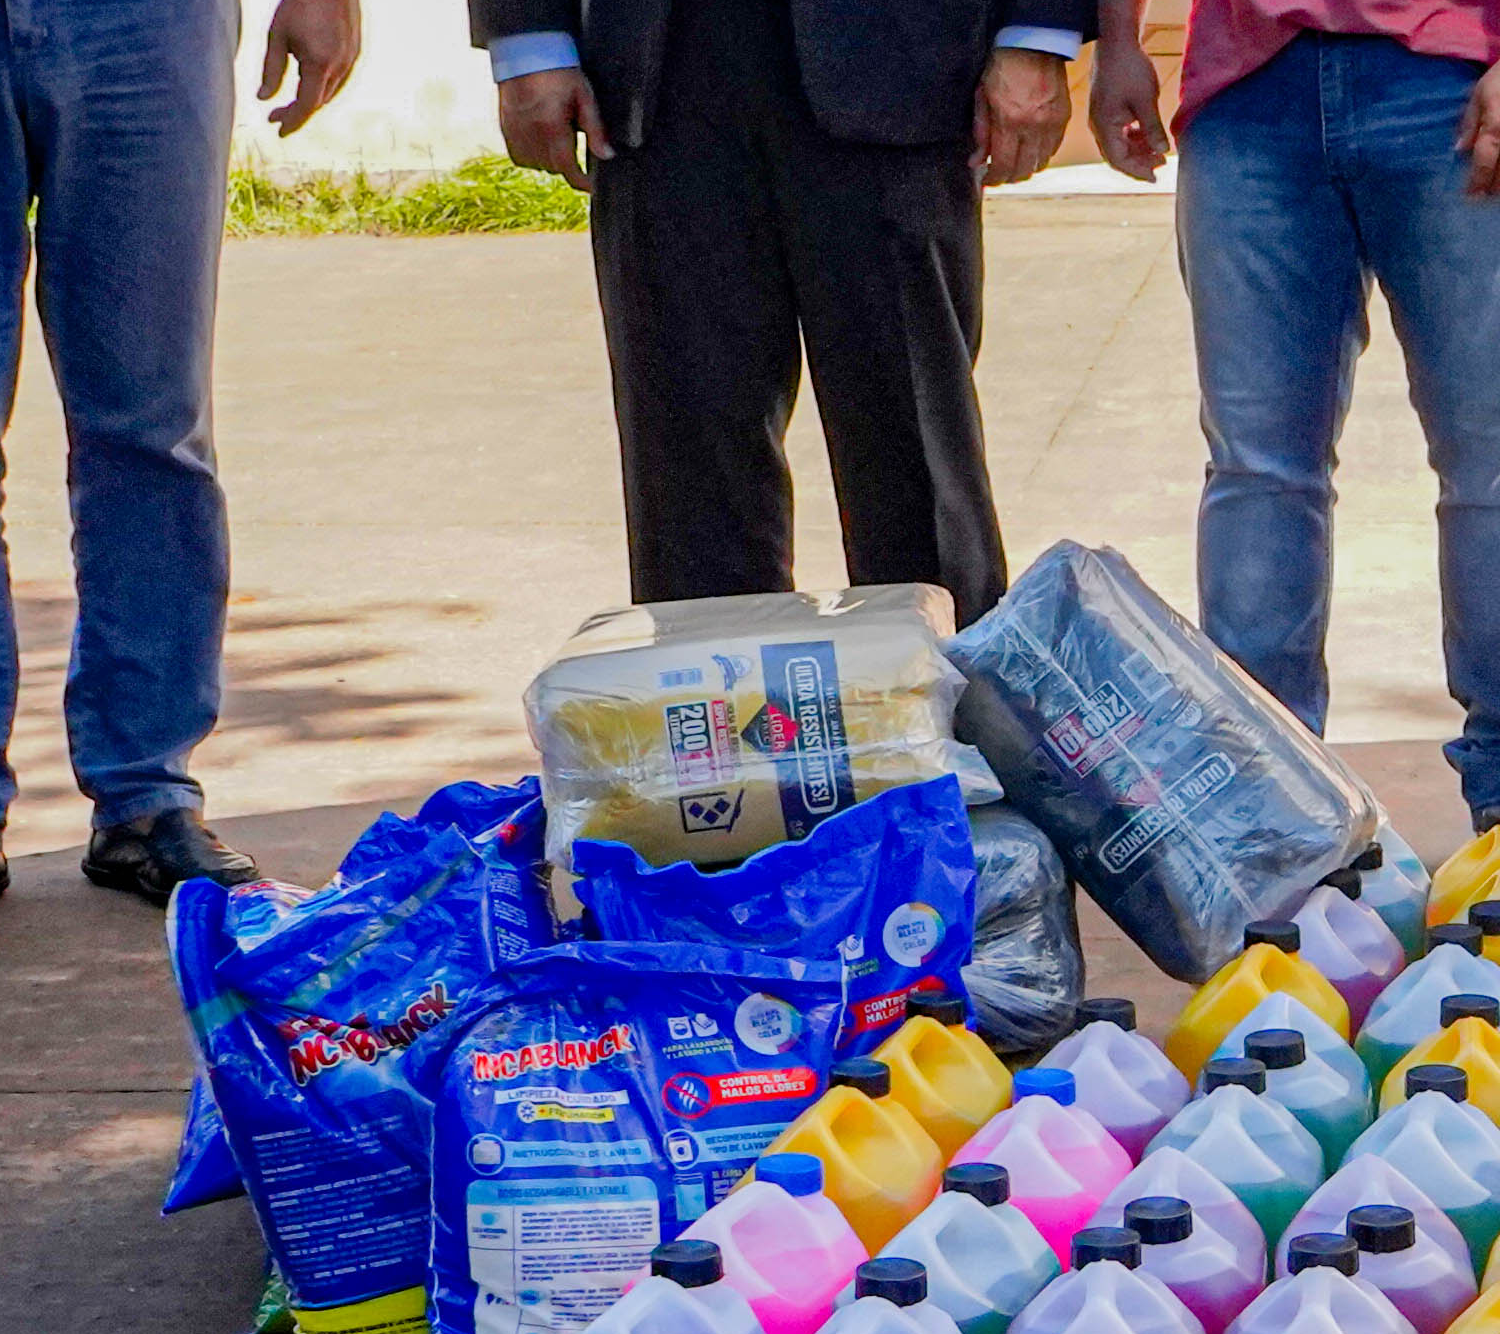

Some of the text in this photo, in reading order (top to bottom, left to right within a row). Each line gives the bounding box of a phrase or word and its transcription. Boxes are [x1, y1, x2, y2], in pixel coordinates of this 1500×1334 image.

[680, 704, 710, 752] 200
[771, 712, 787, 754] LIDER
[794, 665, 831, 803] ULTRA RESISTENTES!
[1181, 762, 1226, 800] ULTRA
[864, 994, 907, 1014] CONTR
[508, 1088, 560, 1102] LIMPIEZA
[719, 1073, 789, 1088] CONTROL DE
[721, 1081, 807, 1098] MALOS OLORES
